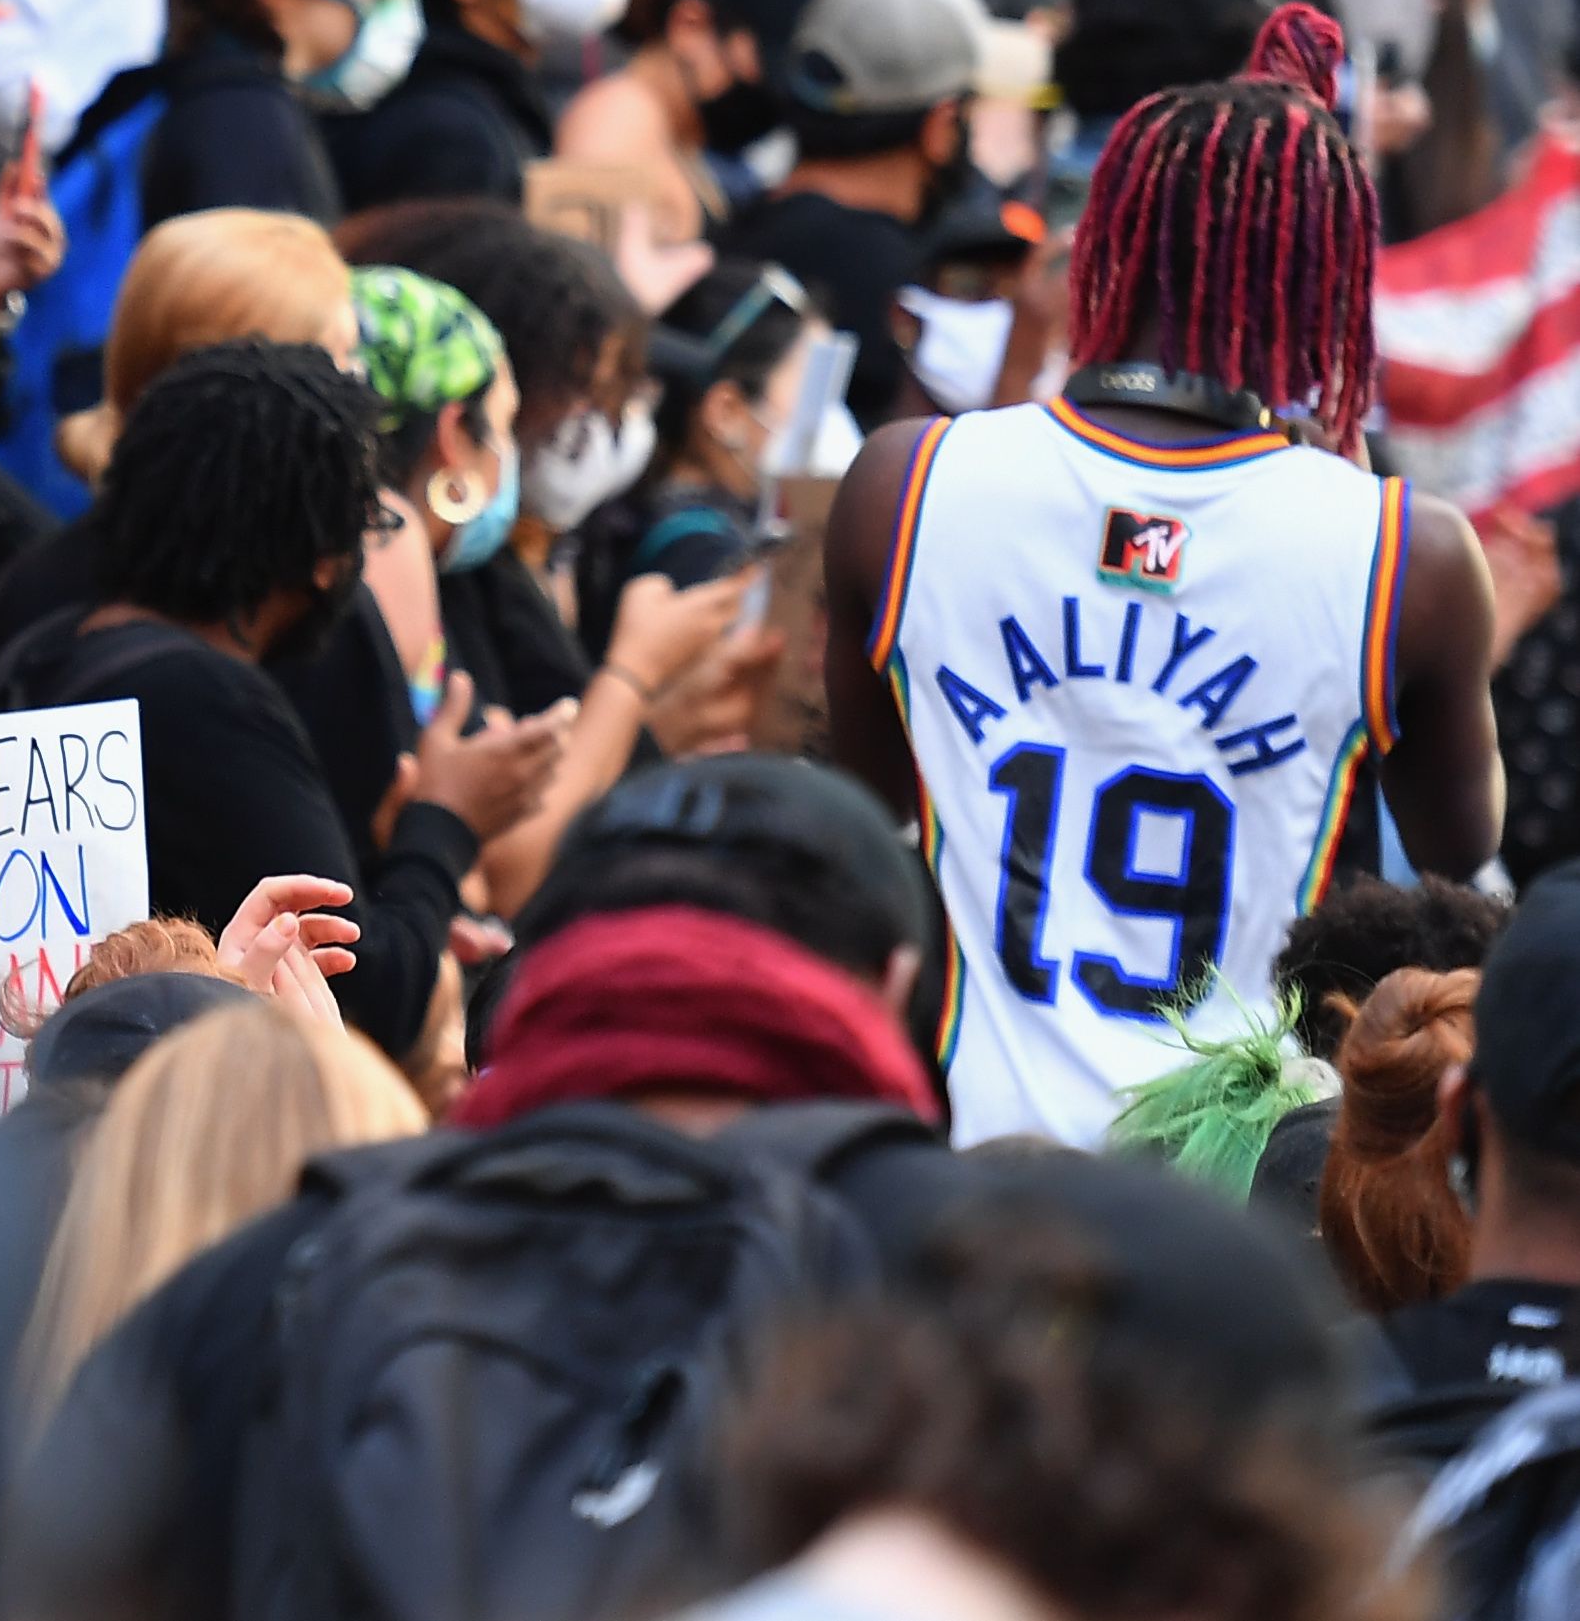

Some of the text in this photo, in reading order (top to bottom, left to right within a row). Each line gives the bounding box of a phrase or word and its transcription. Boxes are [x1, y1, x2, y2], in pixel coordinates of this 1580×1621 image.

[1101, 508, 1190, 583] MTV
[934, 595, 1307, 778] AALIYAH
[987, 741, 1237, 1023] 19
